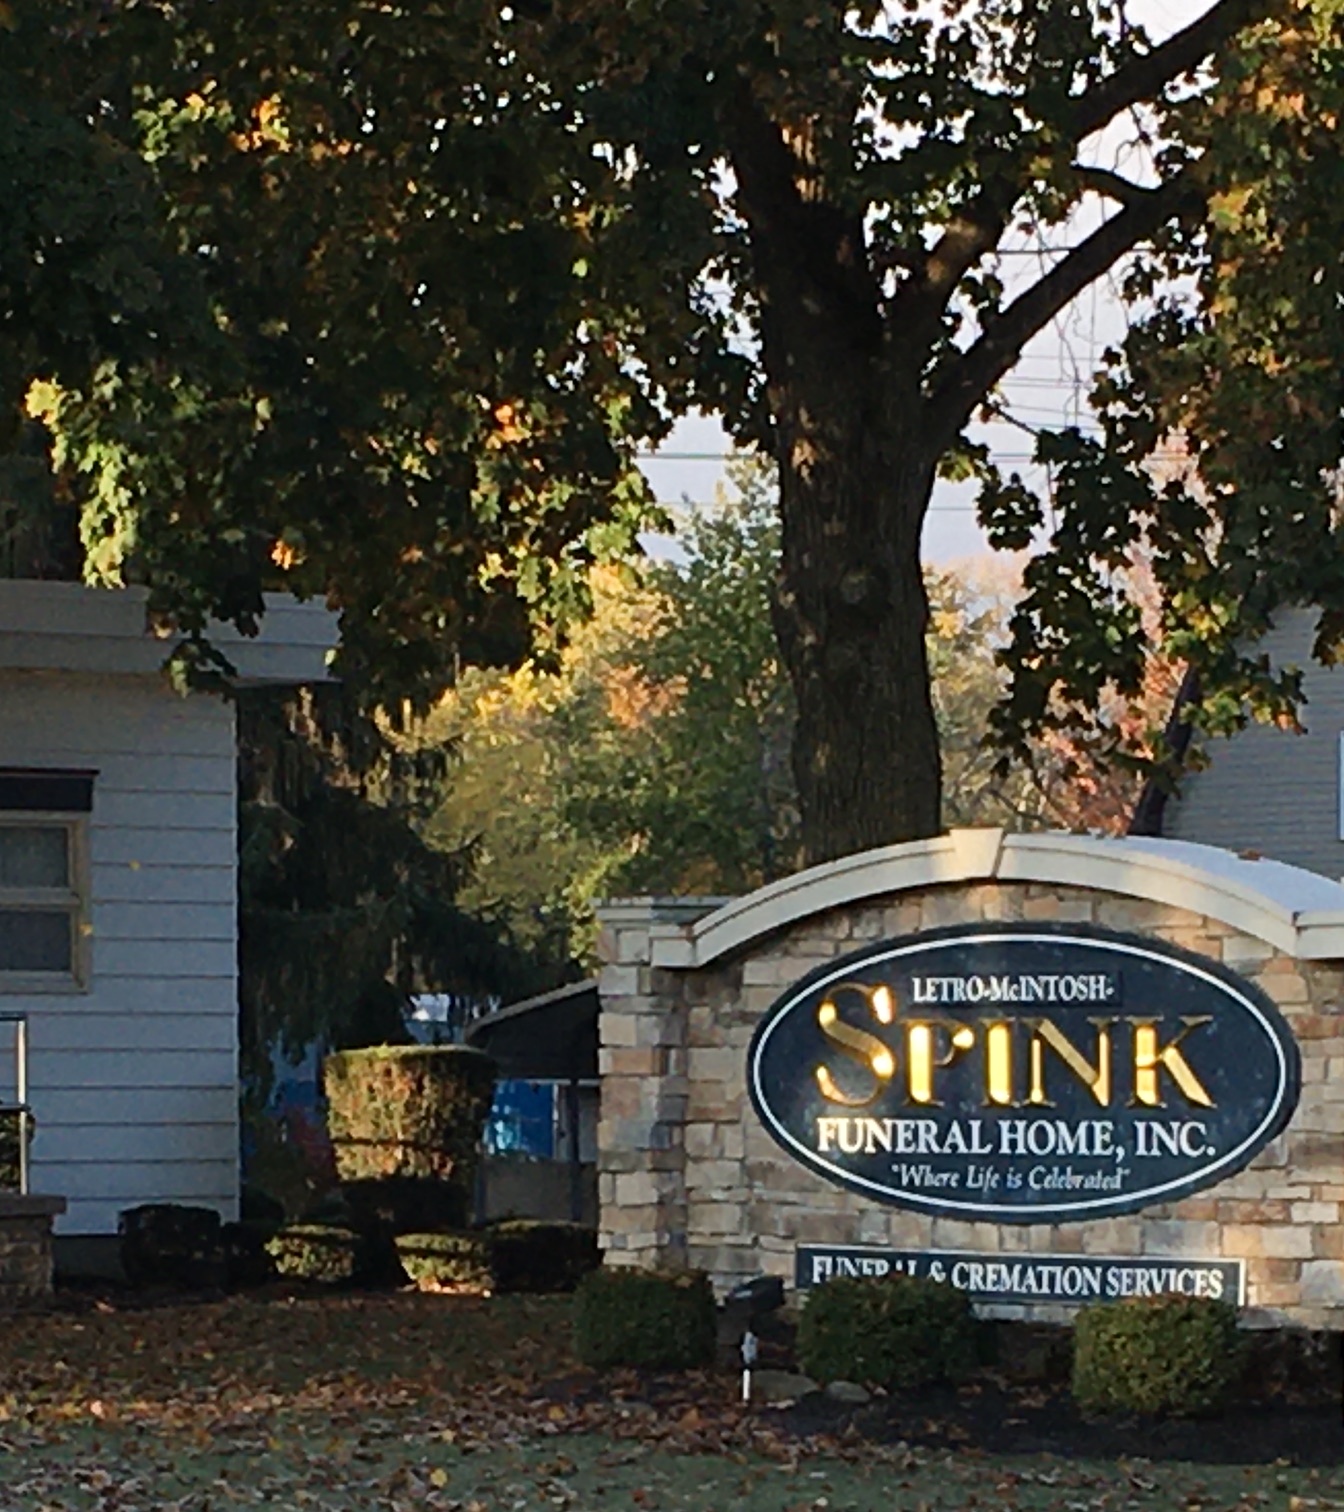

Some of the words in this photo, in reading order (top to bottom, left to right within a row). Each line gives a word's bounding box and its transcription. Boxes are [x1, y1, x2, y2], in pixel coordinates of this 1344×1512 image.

[816, 982, 1216, 1107] SPINK
[818, 1117, 992, 1155] FUNERAL
[998, 1118, 1125, 1163] HOME,
[1133, 1121, 1216, 1157] INC.
[966, 1164, 999, 1194] Life
[1006, 1167, 1022, 1190] is
[929, 1261, 946, 1283] &
[951, 1262, 1102, 1296] CREMATION
[1106, 1266, 1223, 1299] SERVICES
